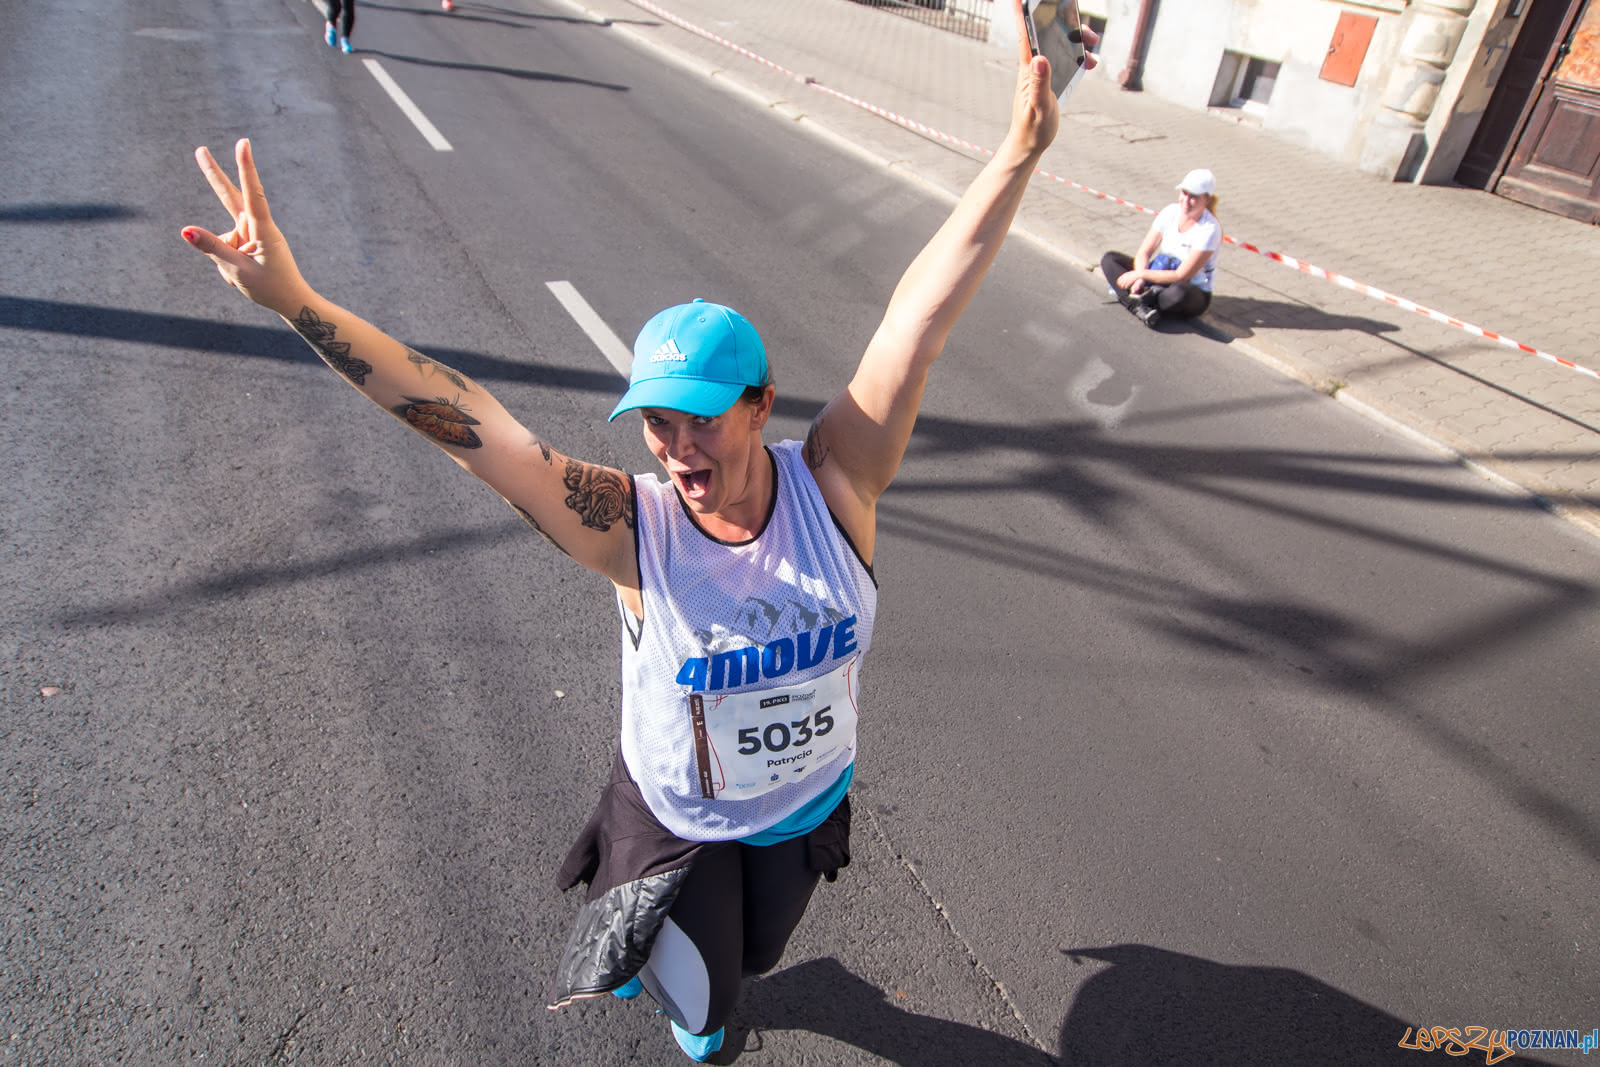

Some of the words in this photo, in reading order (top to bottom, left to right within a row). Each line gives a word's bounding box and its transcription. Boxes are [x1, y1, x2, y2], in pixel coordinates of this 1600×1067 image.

[650, 352, 688, 363] adidas
[737, 705, 834, 756] 5035
[767, 749, 813, 768] Patrycja
